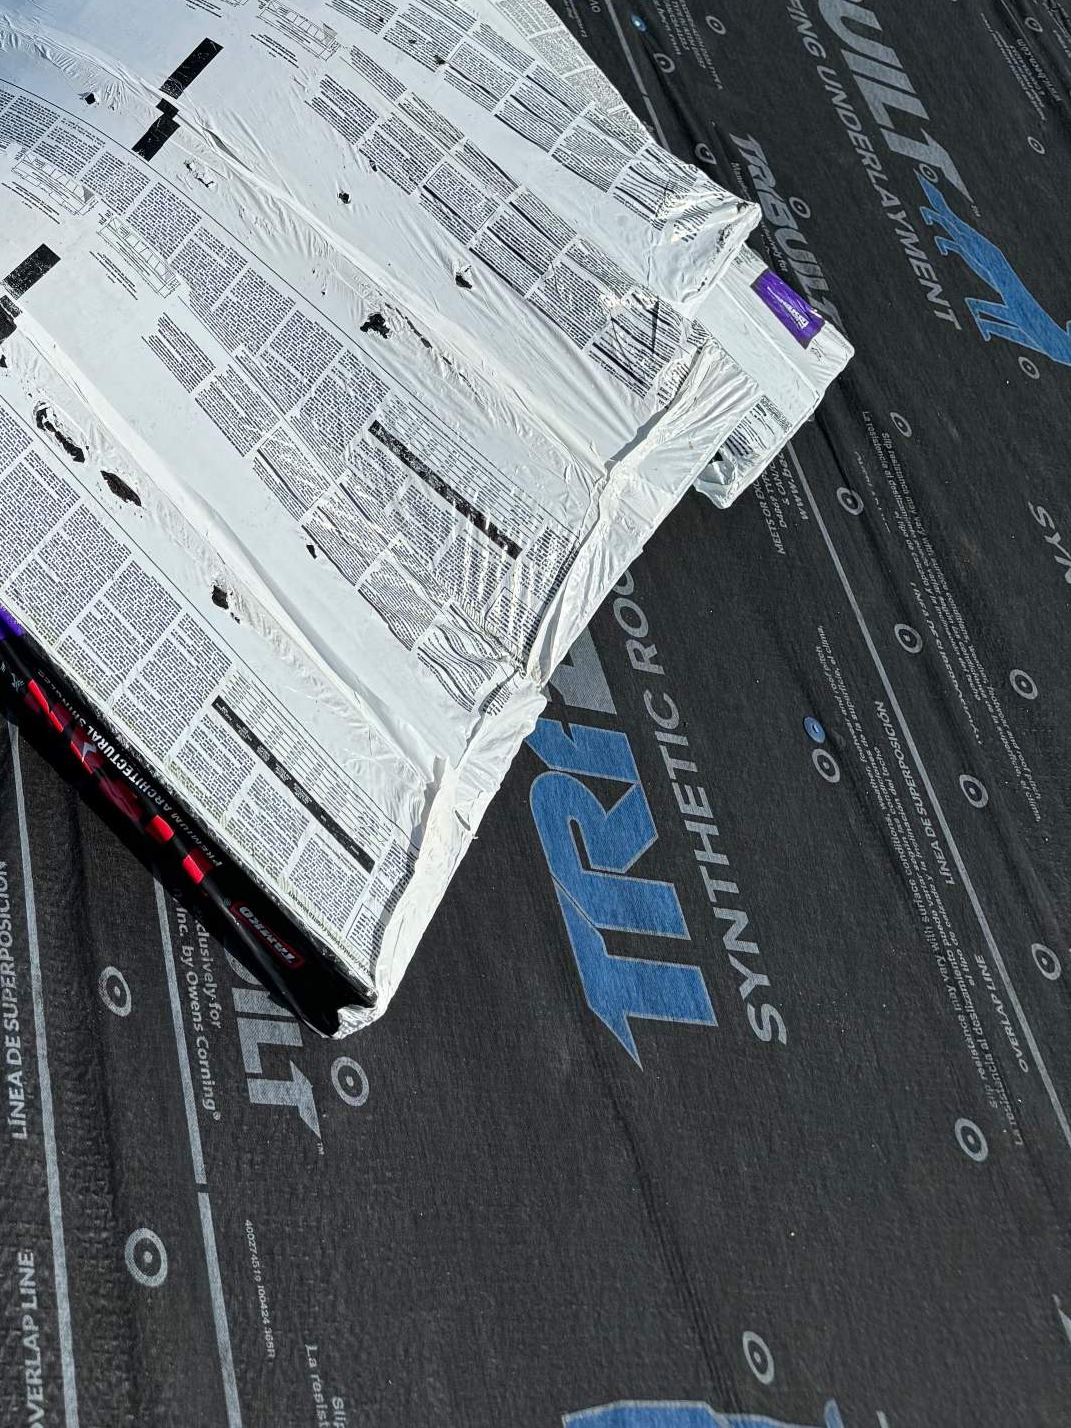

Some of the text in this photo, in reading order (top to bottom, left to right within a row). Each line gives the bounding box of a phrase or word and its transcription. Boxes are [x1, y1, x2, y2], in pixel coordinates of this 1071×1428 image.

[815, 66, 964, 332] UNDERLAYMENT
[749, 479, 765, 499] EXC
[769, 462, 786, 495] CAN/C
[773, 451, 809, 519] www.bec
[759, 501, 771, 517] OR
[87, 725, 172, 811] ARCHITECTURAL
[874, 700, 955, 884] LÍNEA DE SUPERPOSICIÓN
[643, 689, 787, 1044] SYNTHETIC
[180, 945, 194, 968] by
[232, 906, 295, 963] TAMKO
[185, 971, 206, 1032] Owens
[208, 1002, 222, 1029] for
[973, 953, 1029, 1073] OVERLAP LINE
[5, 1034, 22, 1065] DE
[7, 1070, 28, 1139] LÍNEA
[17, 1249, 38, 1309] LINE
[310, 1374, 330, 1428] resist
